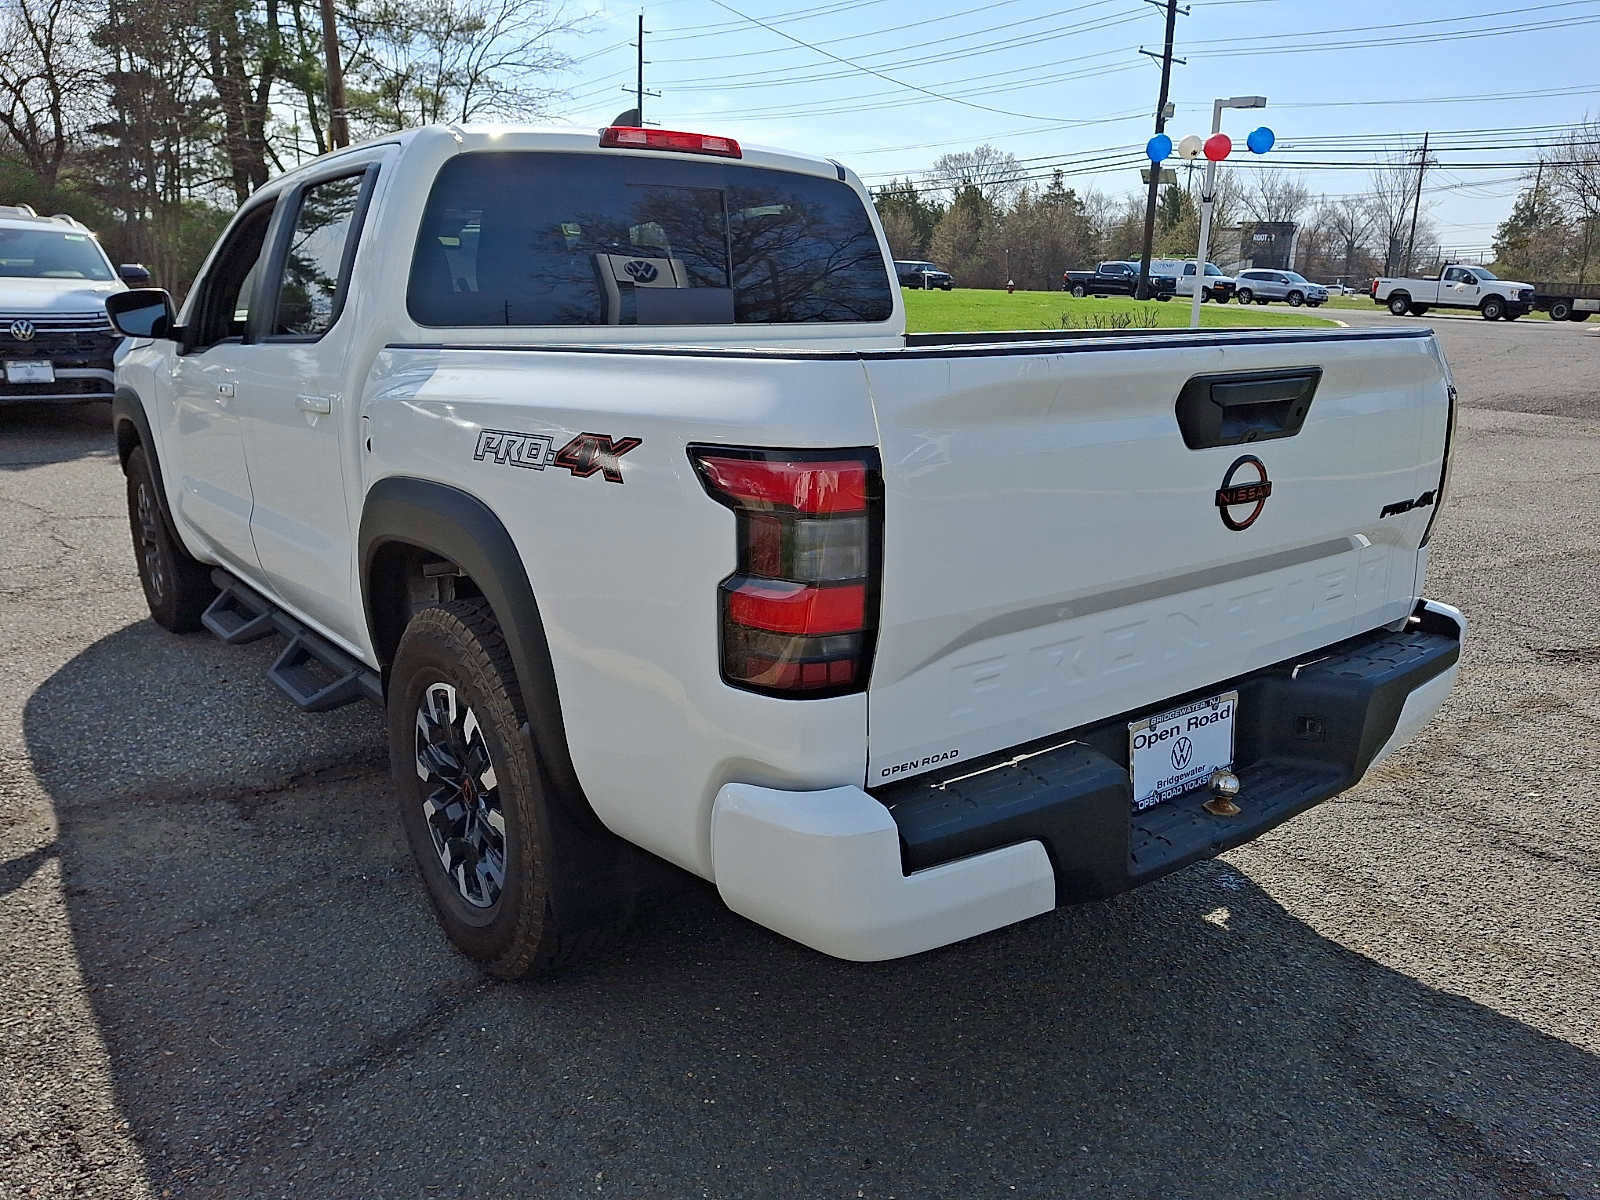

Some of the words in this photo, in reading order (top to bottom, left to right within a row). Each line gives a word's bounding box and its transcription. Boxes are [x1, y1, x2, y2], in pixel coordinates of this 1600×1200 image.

[1219, 485, 1271, 504] NISSAN
[1133, 725, 1181, 749] Open
[1187, 705, 1231, 732] Road
[881, 760, 919, 777] OPEN
[922, 749, 959, 766] ROAD
[1156, 764, 1207, 789] Bridgewater
[1138, 794, 1160, 810] OPEN
[1161, 785, 1183, 801] ROAD
